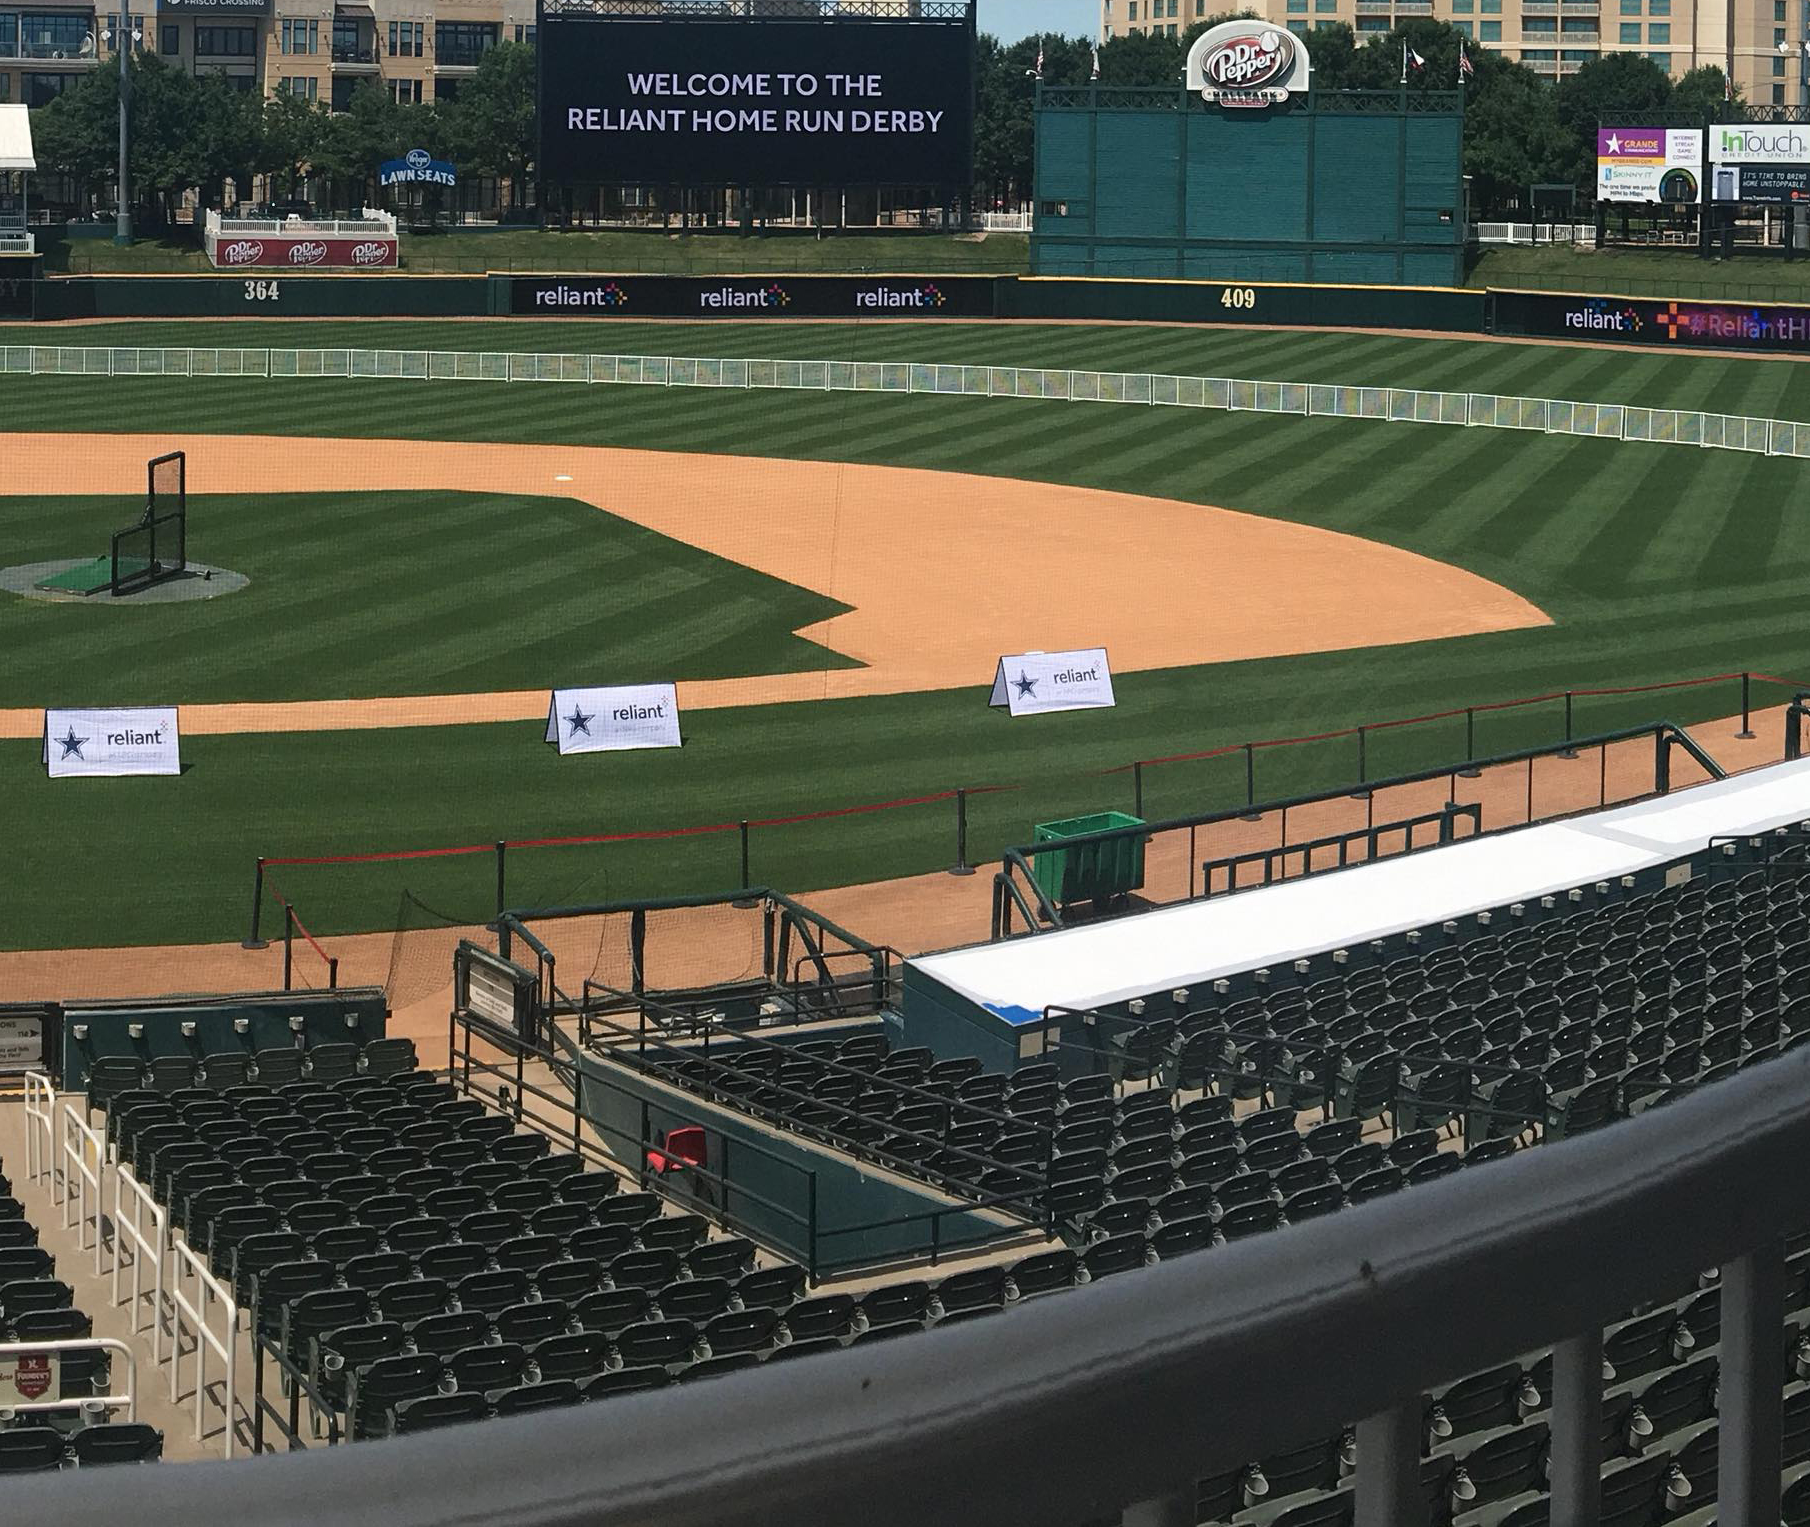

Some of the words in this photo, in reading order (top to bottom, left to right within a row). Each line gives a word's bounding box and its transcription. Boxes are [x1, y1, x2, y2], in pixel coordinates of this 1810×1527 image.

[1235, 45, 1260, 64] Dr
[1218, 49, 1275, 82] Pepper
[628, 73, 771, 96] WELCOME
[777, 73, 818, 96] TO
[825, 74, 882, 96] THE
[568, 108, 686, 131] RELIANT
[692, 110, 777, 132] HOME
[785, 110, 843, 132] RUN
[852, 110, 943, 132] DERBY
[1624, 140, 1658, 148] GRANDE
[381, 170, 415, 186] LAWN
[417, 170, 456, 186] SEATS
[244, 281, 279, 300] 364
[536, 287, 605, 306] reliant
[701, 288, 768, 307] reliant
[856, 288, 923, 307] reliant
[1221, 288, 1255, 308] 409
[1566, 311, 1623, 331] reliant
[1054, 668, 1098, 684] reliant
[613, 704, 663, 720] reliant
[107, 730, 163, 745] reliant
